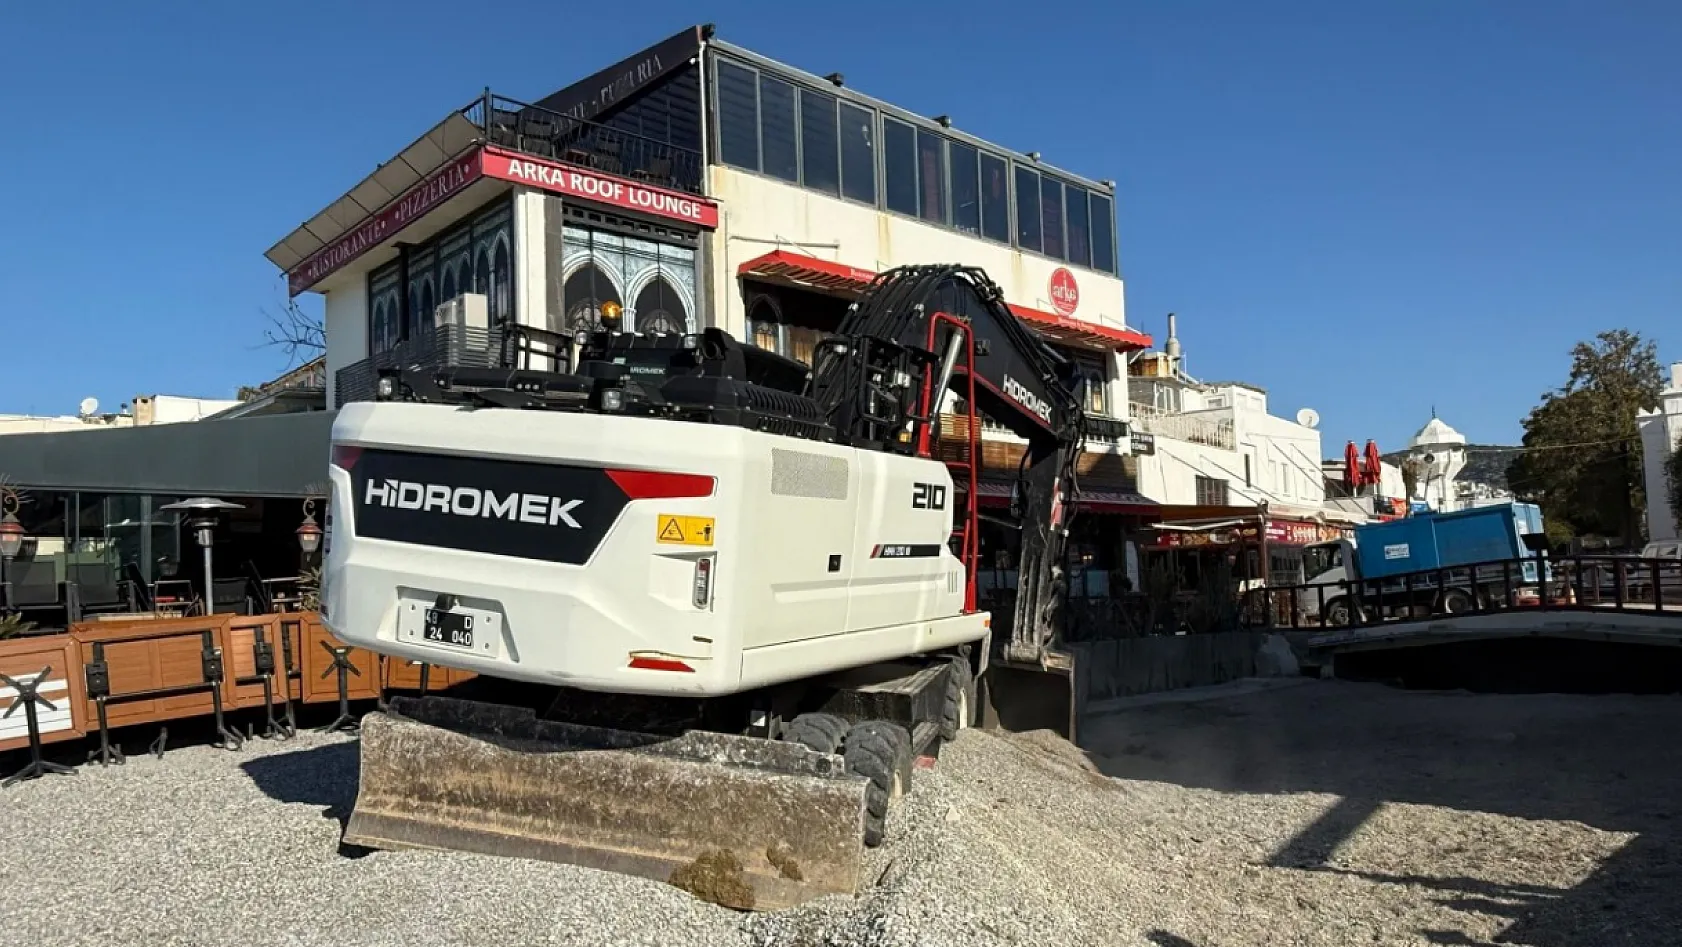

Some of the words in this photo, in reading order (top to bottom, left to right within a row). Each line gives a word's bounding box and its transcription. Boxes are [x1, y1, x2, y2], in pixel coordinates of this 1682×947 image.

[508, 158, 565, 187] ARKA
[570, 172, 624, 201] ROOF
[629, 189, 702, 220] LOUNGE
[312, 218, 381, 280] RISTORANTE
[400, 162, 465, 223] PIZZERIA
[912, 482, 947, 511] 210
[430, 627, 443, 640] 24
[452, 631, 471, 645] 040
[465, 617, 472, 628] D
